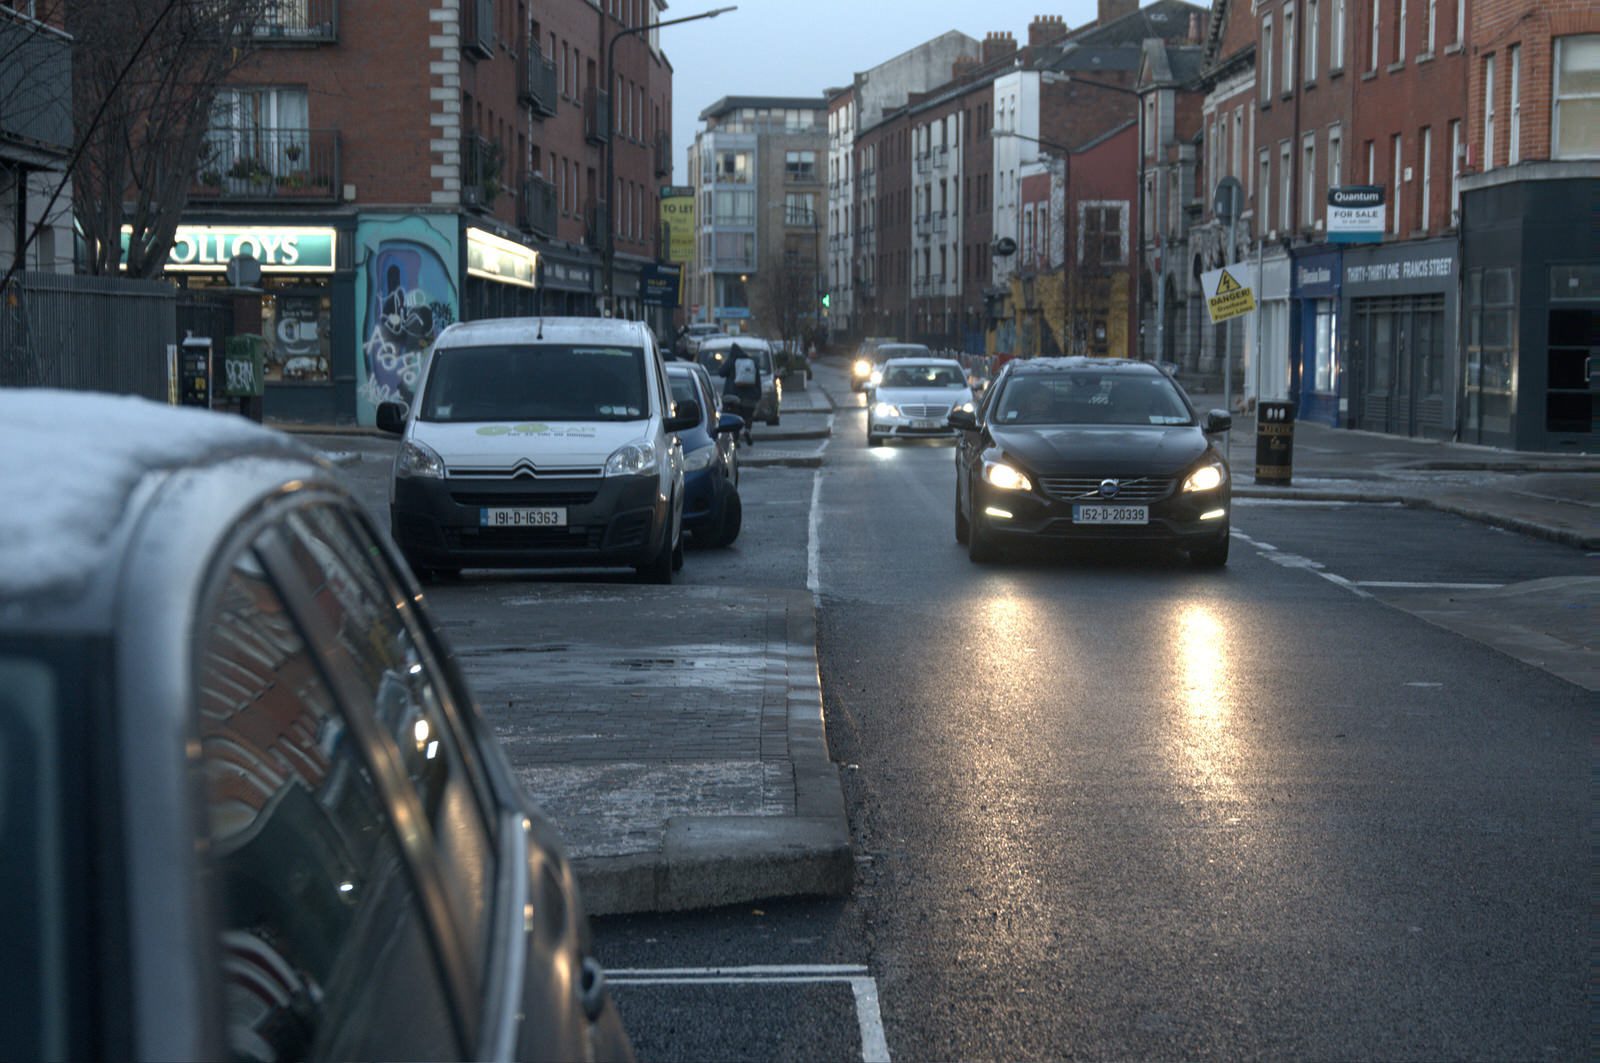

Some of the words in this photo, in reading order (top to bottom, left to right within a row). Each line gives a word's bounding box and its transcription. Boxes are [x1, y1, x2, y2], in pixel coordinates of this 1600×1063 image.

[1334, 191, 1379, 203] Quantum
[663, 203, 677, 214] TO
[679, 203, 693, 214] LET
[1334, 210, 1353, 218] FOR
[1355, 210, 1378, 218] SALE
[168, 233, 300, 265] OLLOYS
[1387, 262, 1400, 279] ONE
[1402, 259, 1428, 279] FRANCIS
[1429, 257, 1453, 277] STREET
[1210, 287, 1250, 306] DANGER!
[495, 511, 558, 525] 191-D-16363
[1082, 508, 1145, 521] 152-D-20339
